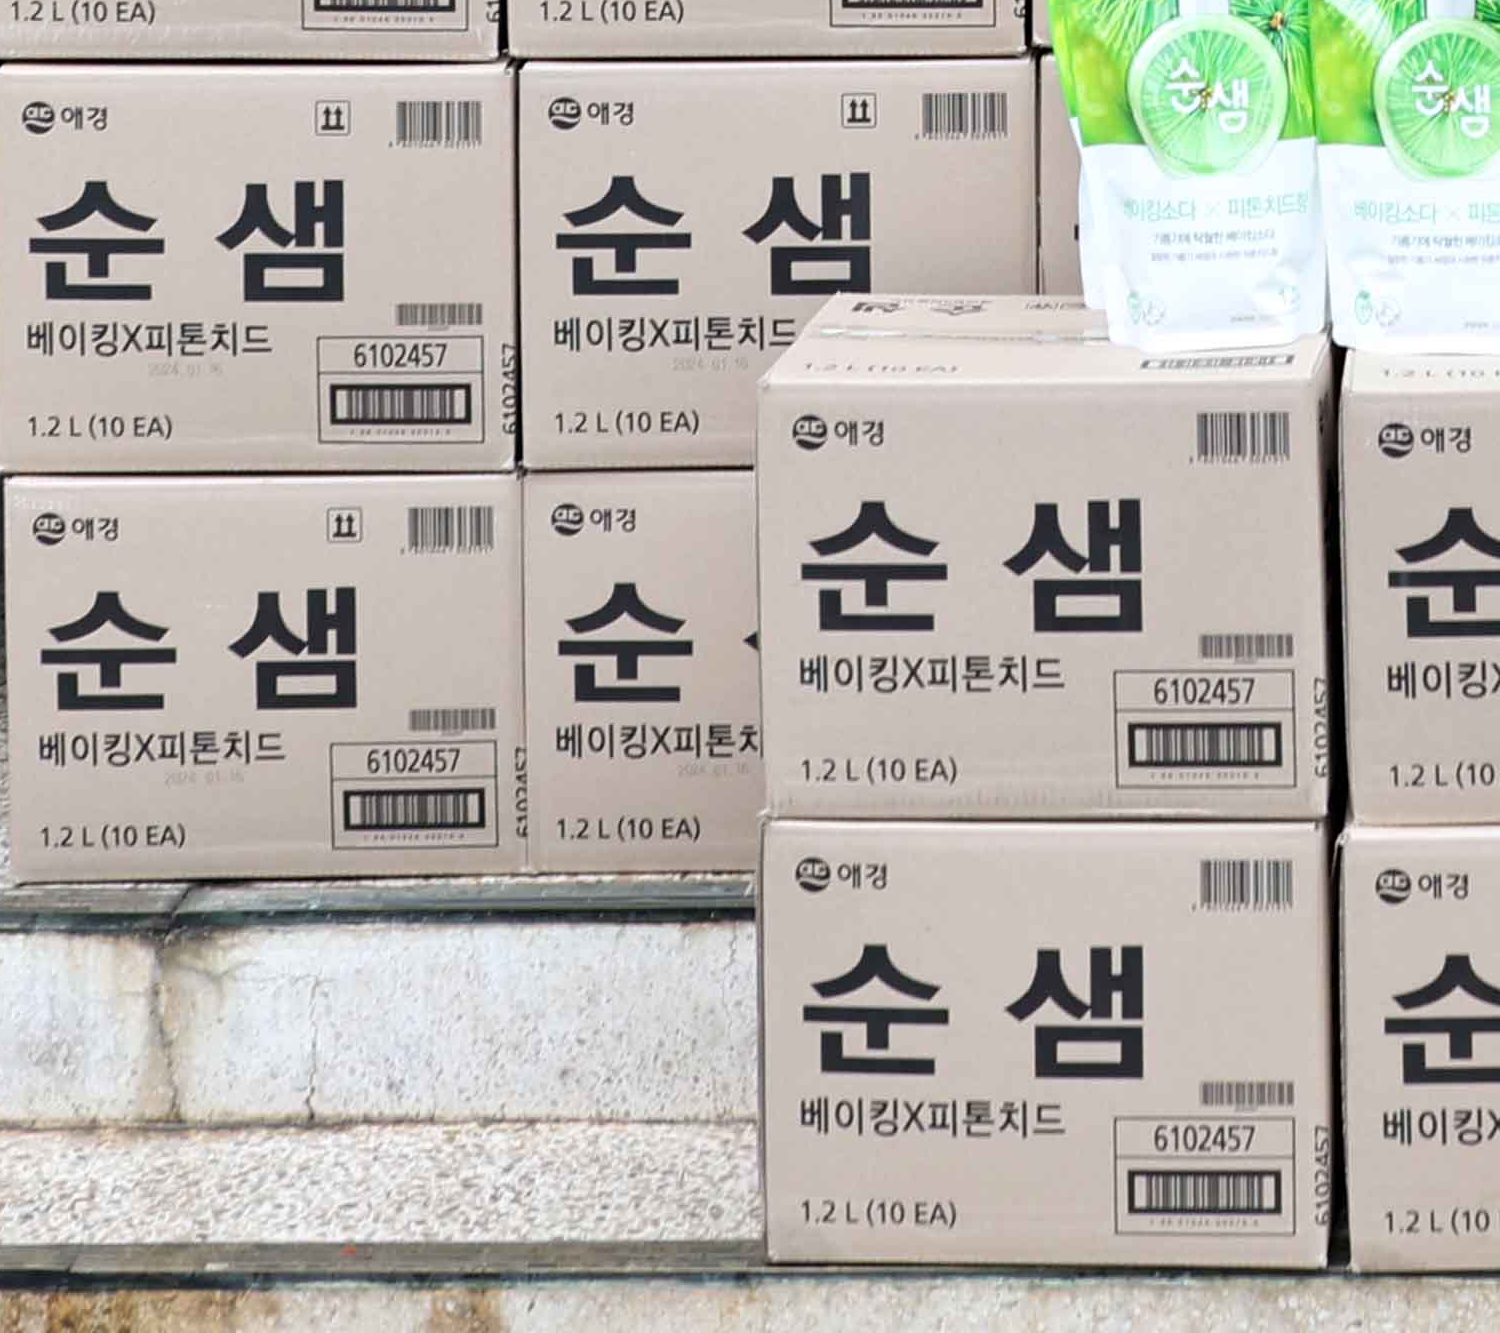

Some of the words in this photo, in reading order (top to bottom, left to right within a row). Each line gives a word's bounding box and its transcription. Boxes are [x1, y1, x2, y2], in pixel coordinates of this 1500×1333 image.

[60, 106, 108, 131] 애경
[29, 180, 165, 301] 순
[216, 180, 344, 302] 샘
[555, 175, 692, 296] 순
[742, 172, 871, 295] 샘
[27, 321, 273, 358] 베이킹X피톤치드
[346, 336, 447, 368] 6102457
[834, 420, 884, 446] 애경
[1420, 427, 1471, 454] 애경
[801, 500, 948, 632] 순
[1003, 498, 1143, 632] 샘
[40, 591, 177, 711] 순
[229, 586, 357, 710] 샘
[799, 655, 1065, 694] 베이킹X피톤치드
[1154, 678, 1255, 705] 6102457
[39, 730, 285, 767] 베이킹X피톤치드
[367, 748, 461, 774] 6102457
[837, 864, 887, 890] 애경
[1417, 874, 1469, 899] 애경
[802, 944, 950, 1076] 순
[1006, 945, 1144, 1079] 샘
[800, 1097, 1065, 1139] 베이킹X피톤치드
[1154, 1125, 1255, 1152] 6102457
[802, 1200, 835, 1223] 1.2
[846, 1201, 858, 1224] L
[866, 1199, 905, 1226] (10
[915, 1202, 957, 1228] EA)
